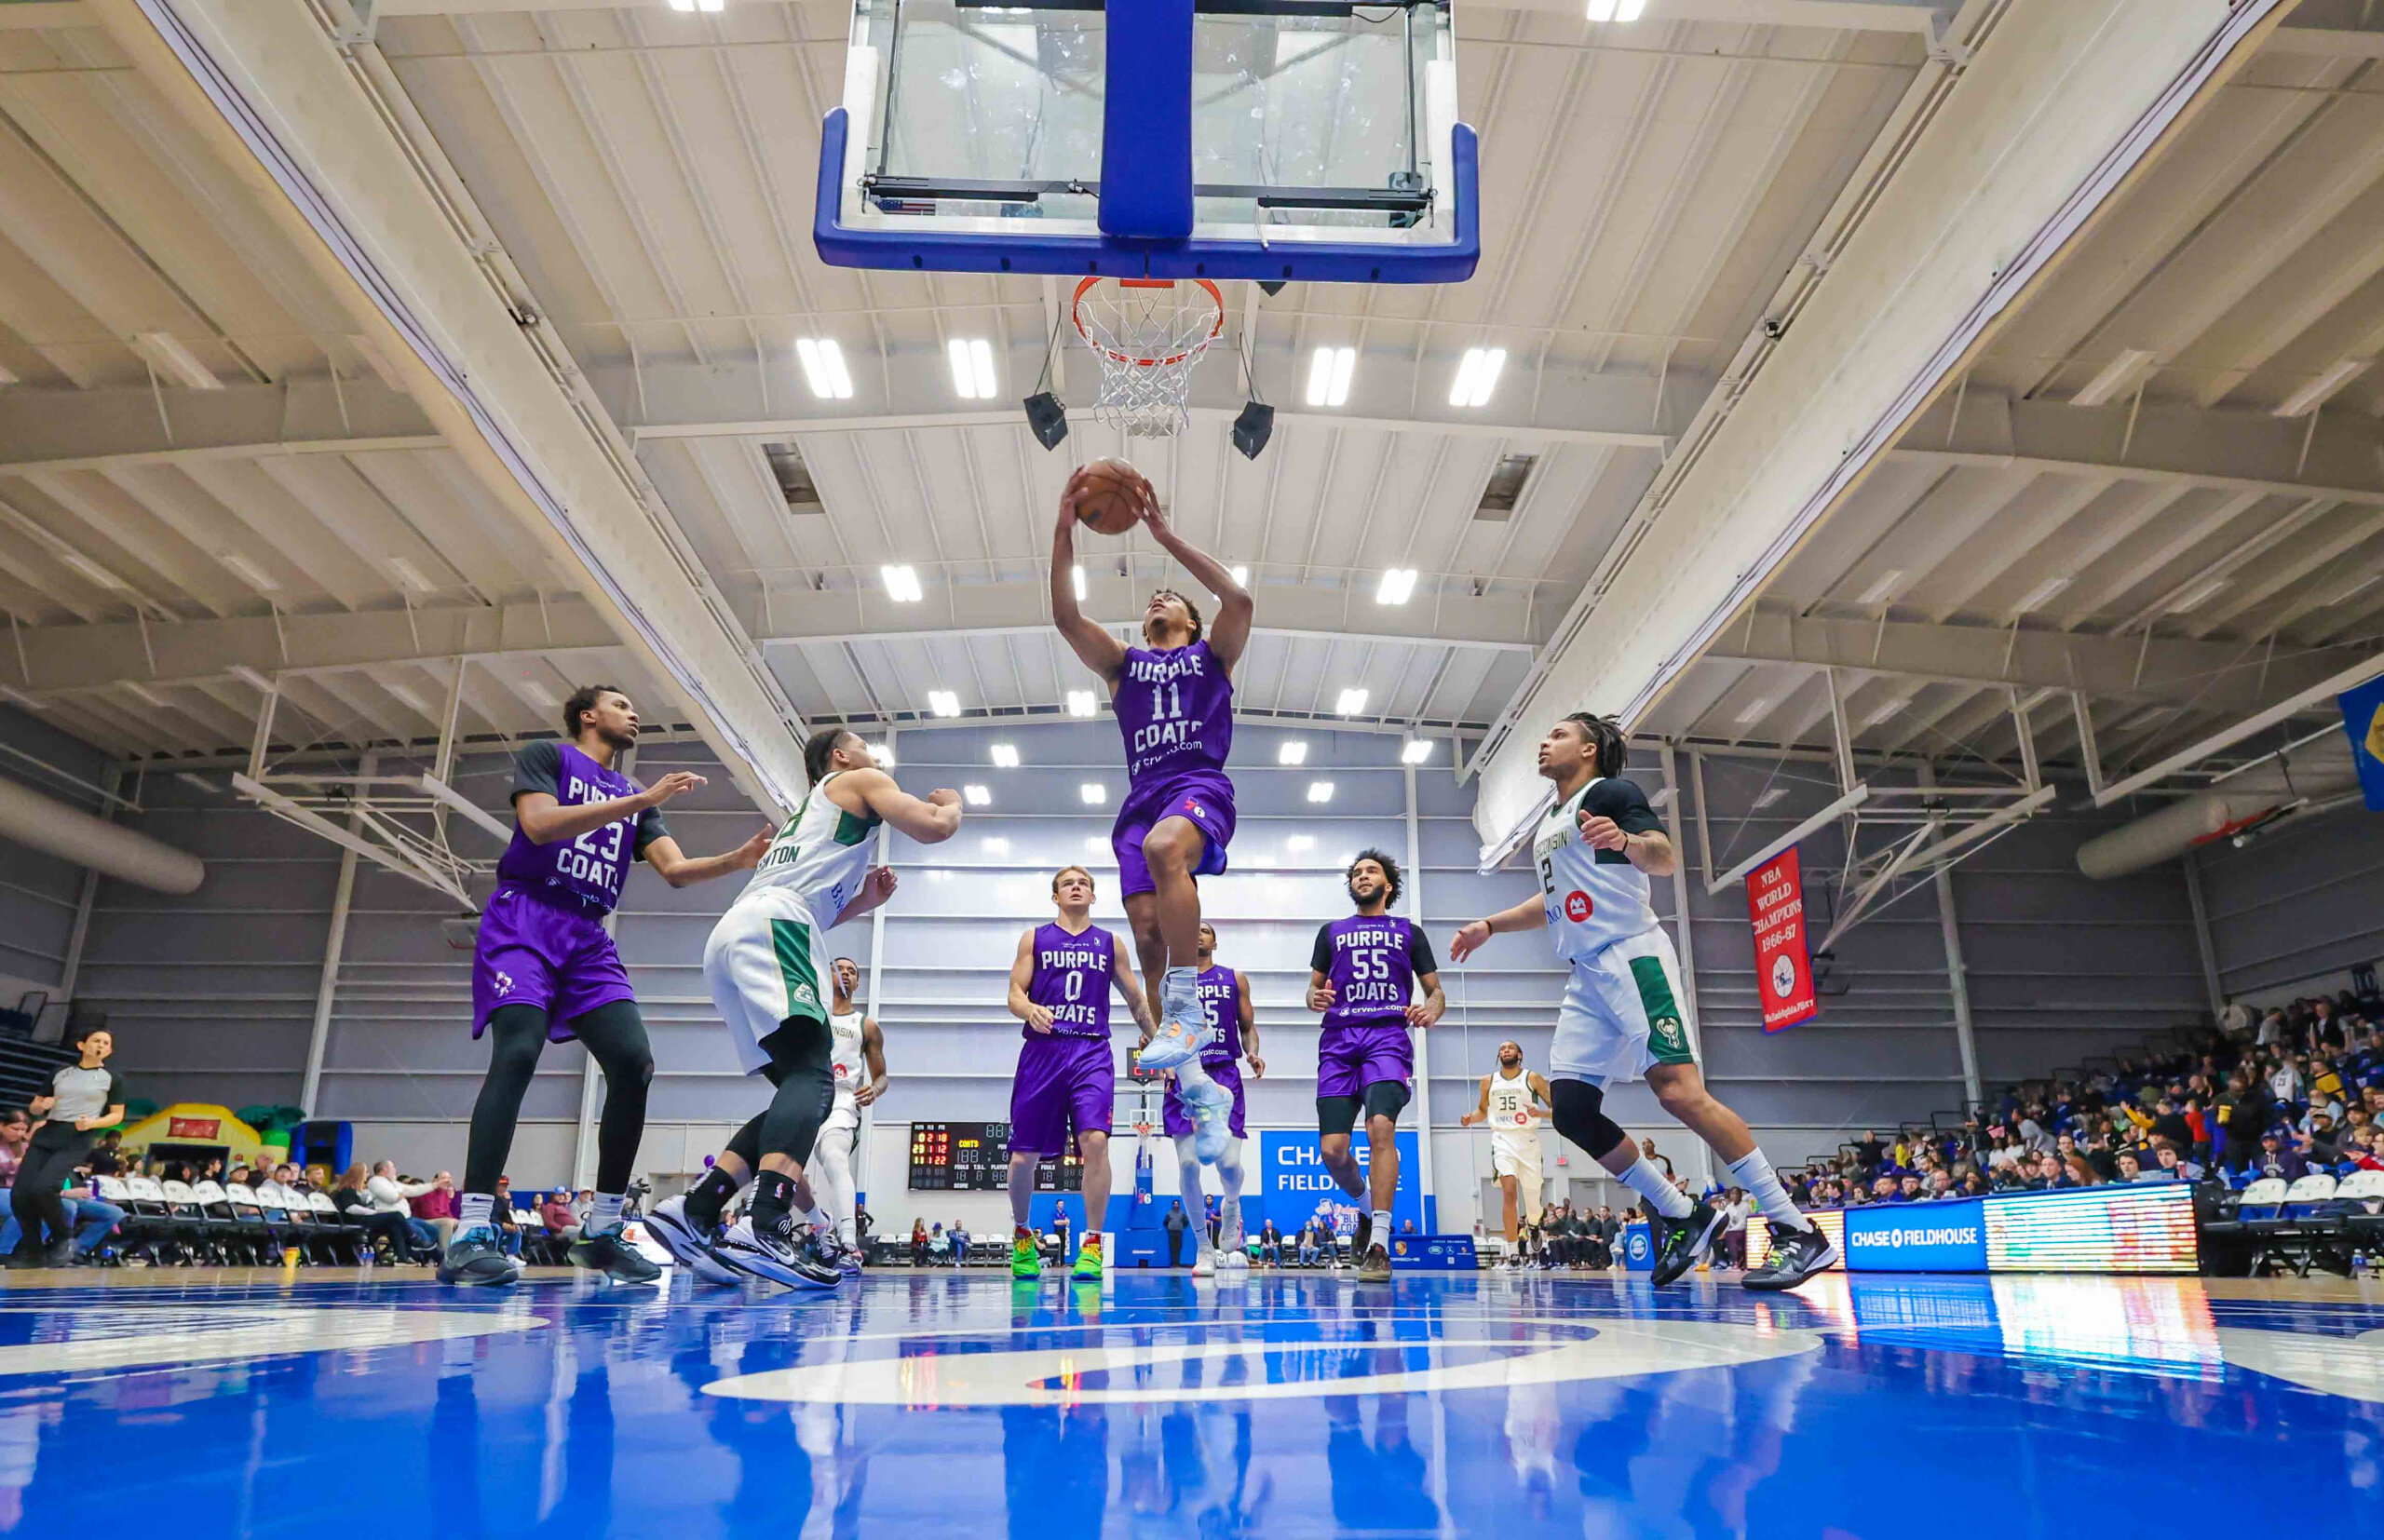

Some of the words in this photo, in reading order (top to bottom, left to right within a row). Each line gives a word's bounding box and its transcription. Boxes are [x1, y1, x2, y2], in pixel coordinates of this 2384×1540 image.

[1152, 682, 1182, 721] 11
[1541, 857, 1555, 895] 2
[1761, 866, 1781, 887] NBA
[1756, 883, 1792, 912] WORLD
[1546, 905, 1562, 925] MO
[1753, 898, 1802, 935] CHAMPIONS
[1336, 931, 1403, 951] PURPLE
[1762, 924, 1796, 952] 1966-67
[1041, 951, 1107, 972] PURPLE
[1351, 949, 1388, 979] 55
[1064, 970, 1083, 1001] 0
[1346, 981, 1398, 1002] COATS
[1499, 1096, 1516, 1110] 35
[1278, 1146, 1370, 1165] CHE
[1852, 1231, 1890, 1247] CHASE
[1904, 1227, 1977, 1246] FIELDHOUSE
